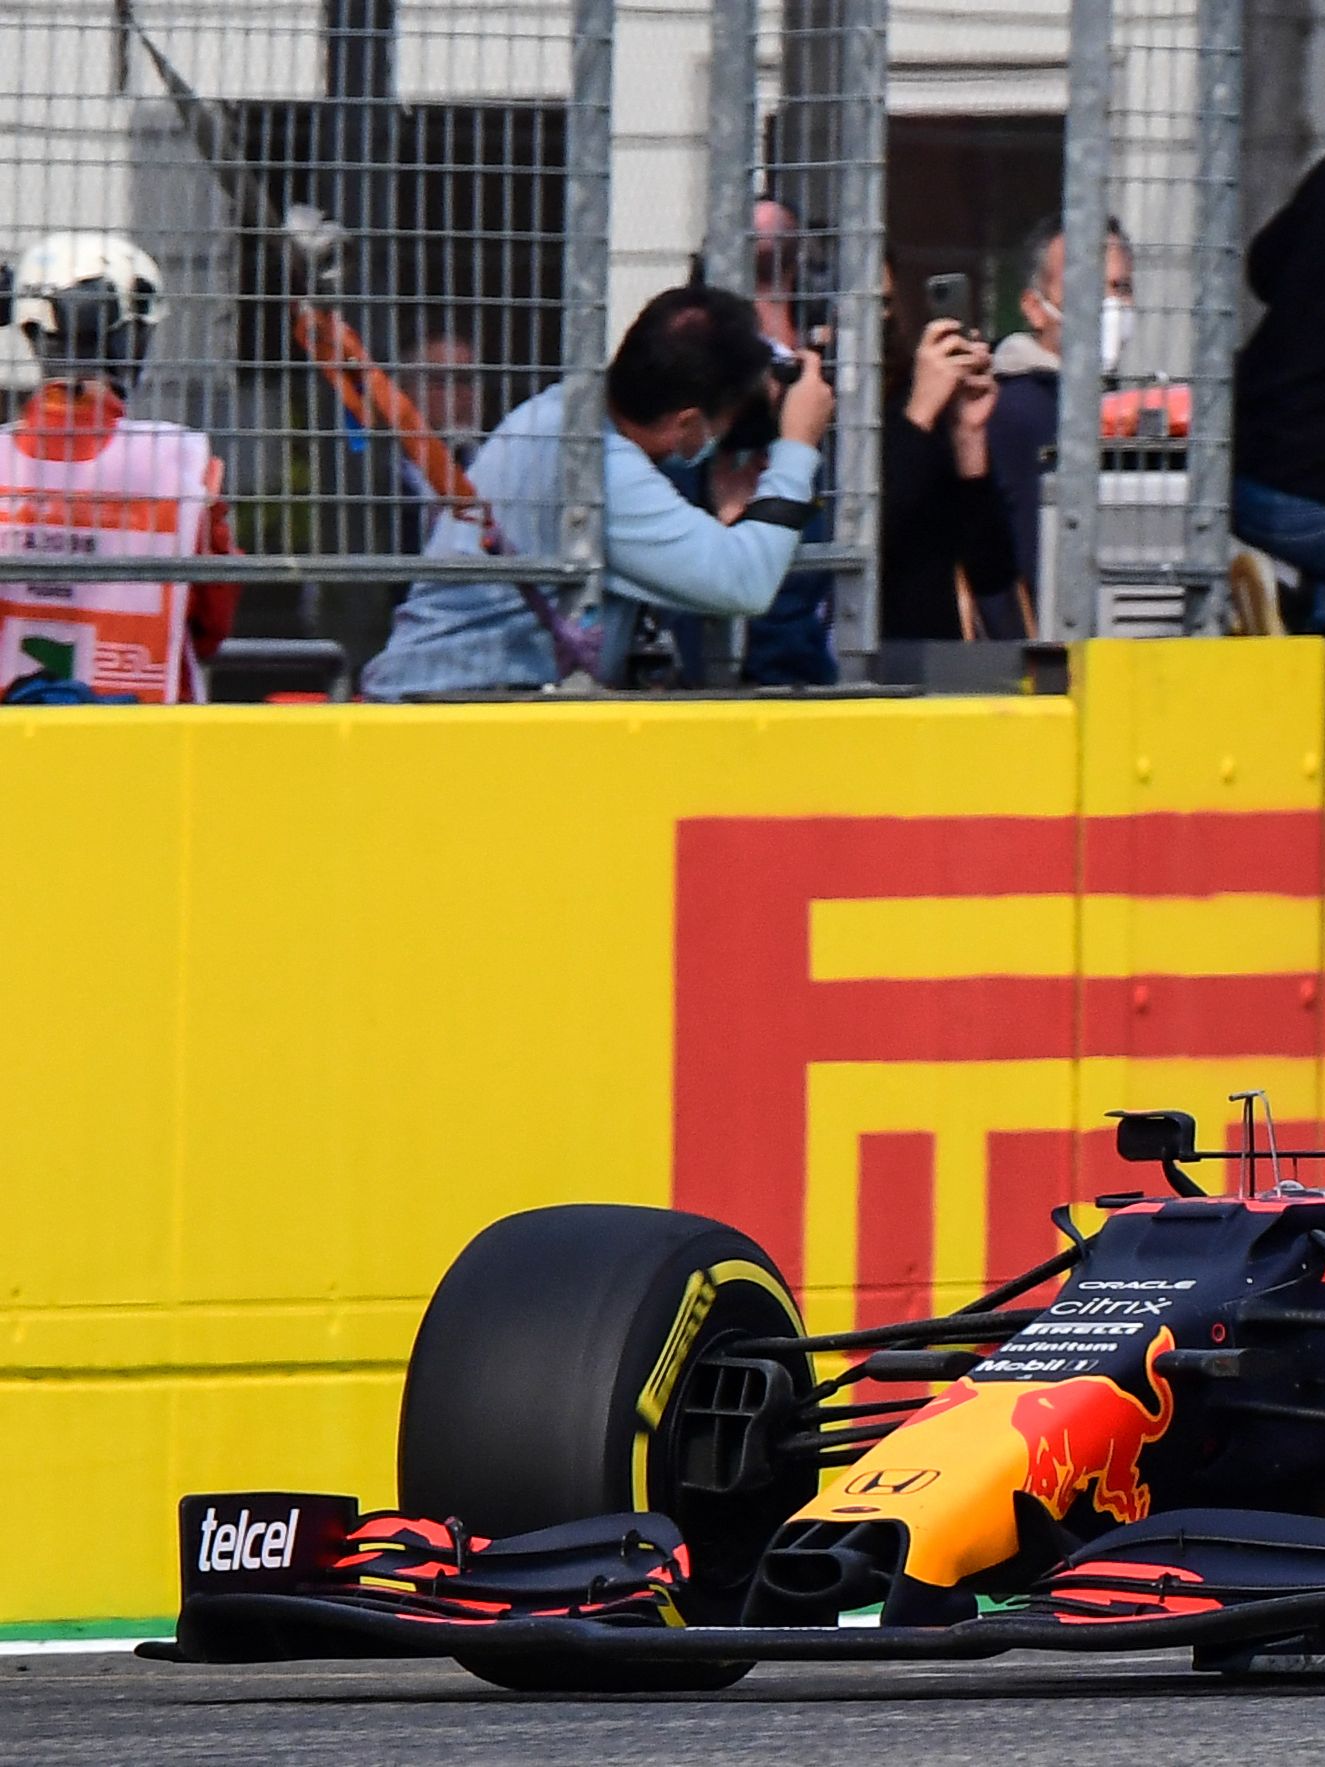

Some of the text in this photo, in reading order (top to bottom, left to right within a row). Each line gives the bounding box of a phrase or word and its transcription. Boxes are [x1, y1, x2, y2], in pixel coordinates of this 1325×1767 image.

[1078, 1280, 1197, 1290] ORACLE
[1050, 1297, 1173, 1315] citrix
[999, 1341, 1119, 1352] infinitum
[974, 1359, 1066, 1372] Mobil
[198, 1507, 300, 1572] telcel
